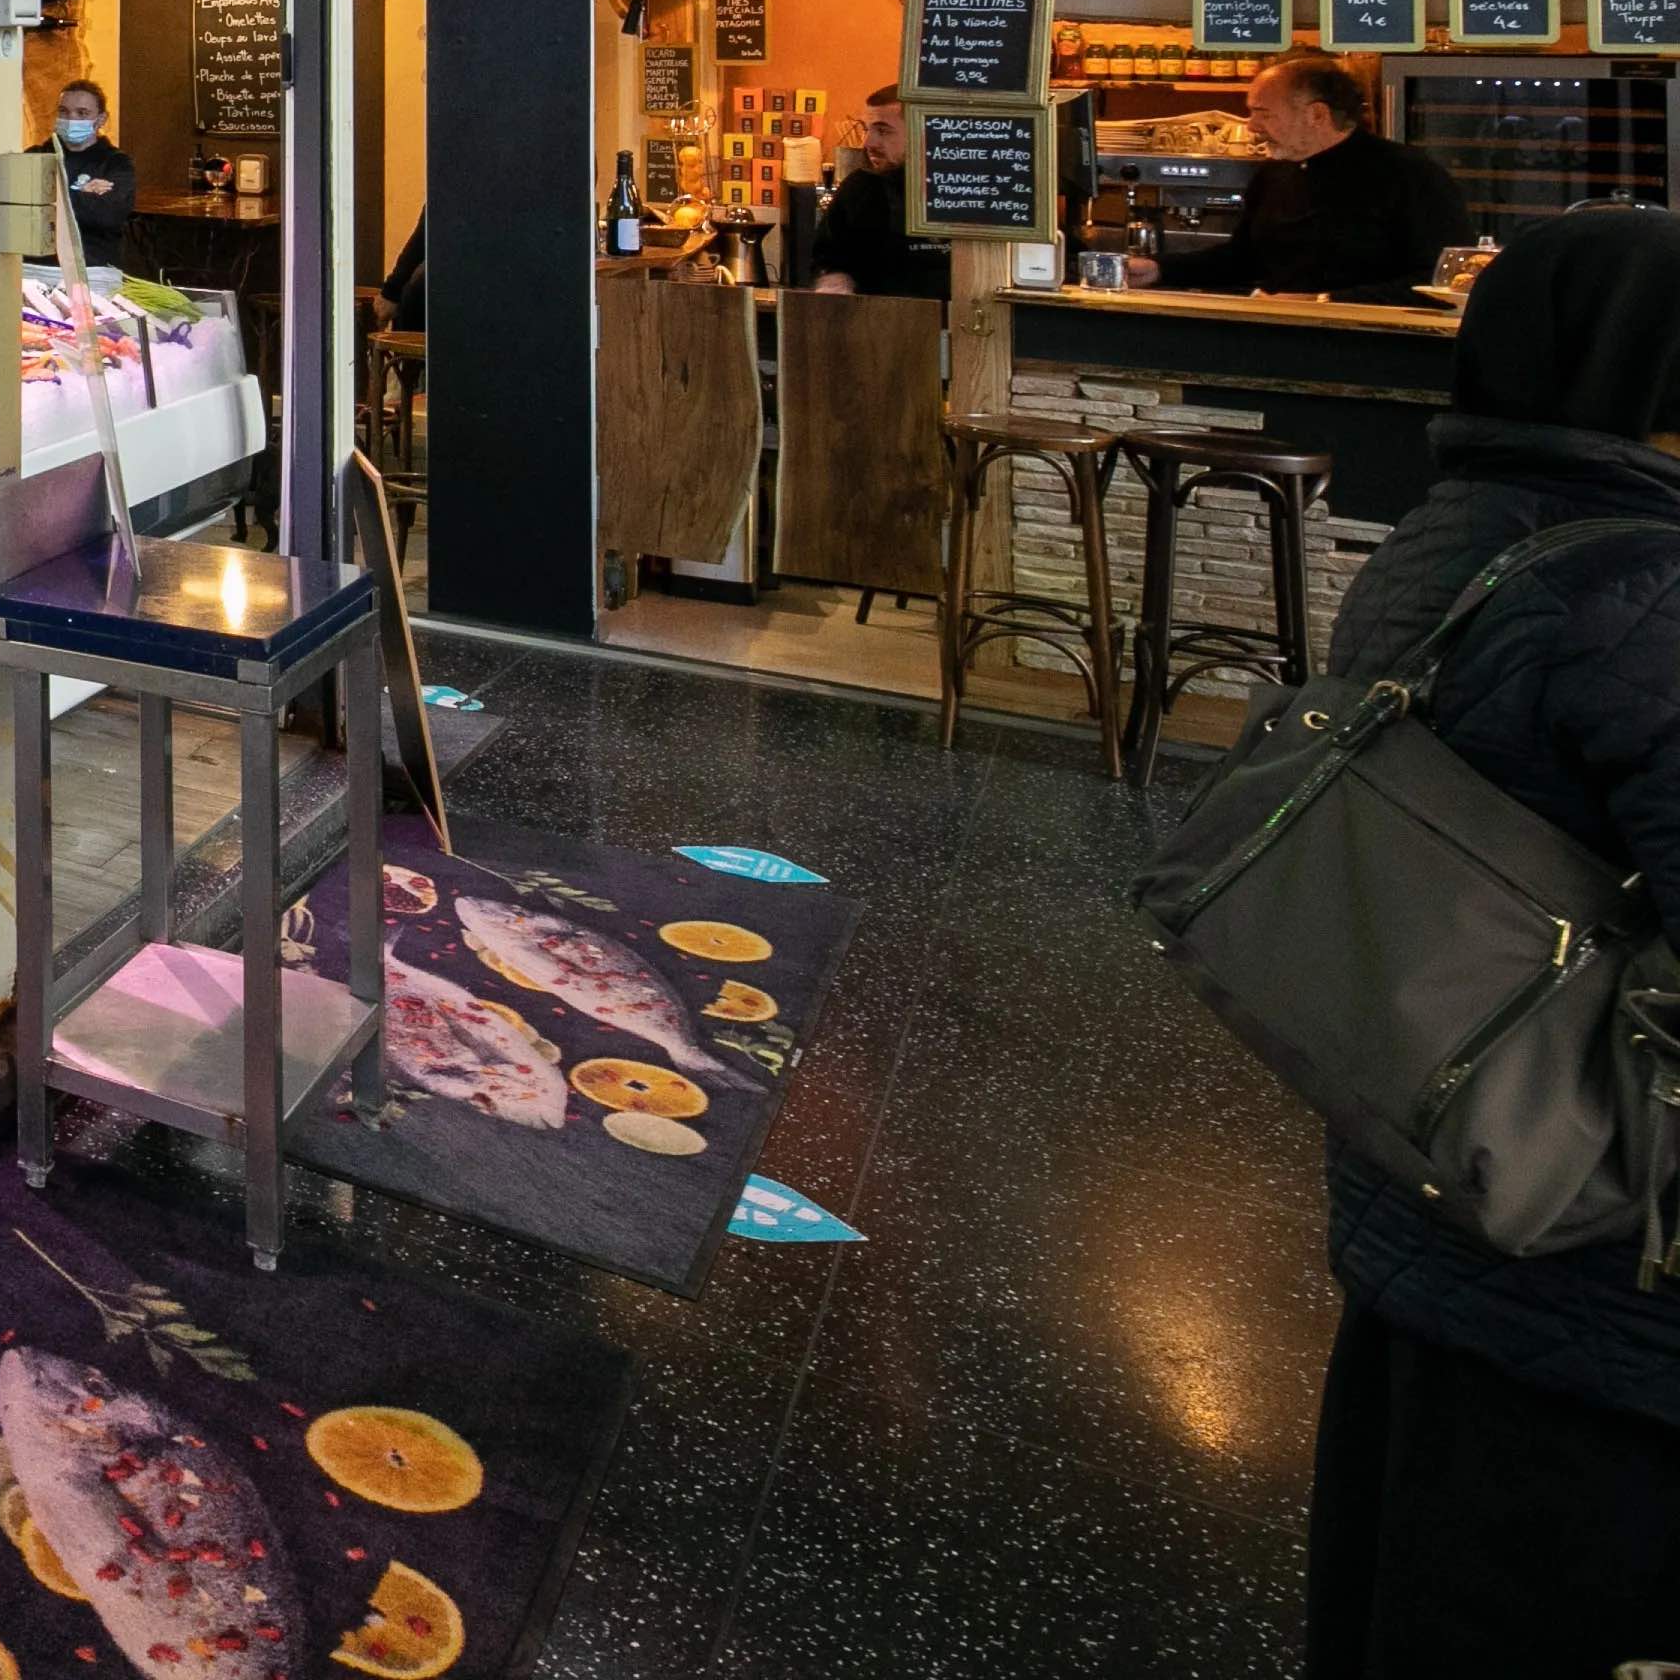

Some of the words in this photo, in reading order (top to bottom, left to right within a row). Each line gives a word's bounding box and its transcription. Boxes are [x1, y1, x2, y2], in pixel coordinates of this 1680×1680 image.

[947, 15, 958, 27] la
[963, 16, 1008, 28] viande
[253, 30, 277, 42] lard
[930, 35, 950, 46] Aux
[955, 36, 1004, 50] légumes
[928, 52, 948, 64] Aux
[200, 69, 235, 82] Planche
[241, 70, 253, 80] de
[221, 105, 274, 119] Tartines
[218, 120, 275, 131] Saucisson
[932, 118, 1013, 130] SAUCISSON
[932, 147, 988, 160] ASSIETTE
[933, 172, 990, 184] PLANCHE
[938, 185, 1000, 195] FROMAGES
[934, 198, 985, 209] BIQUETTE
